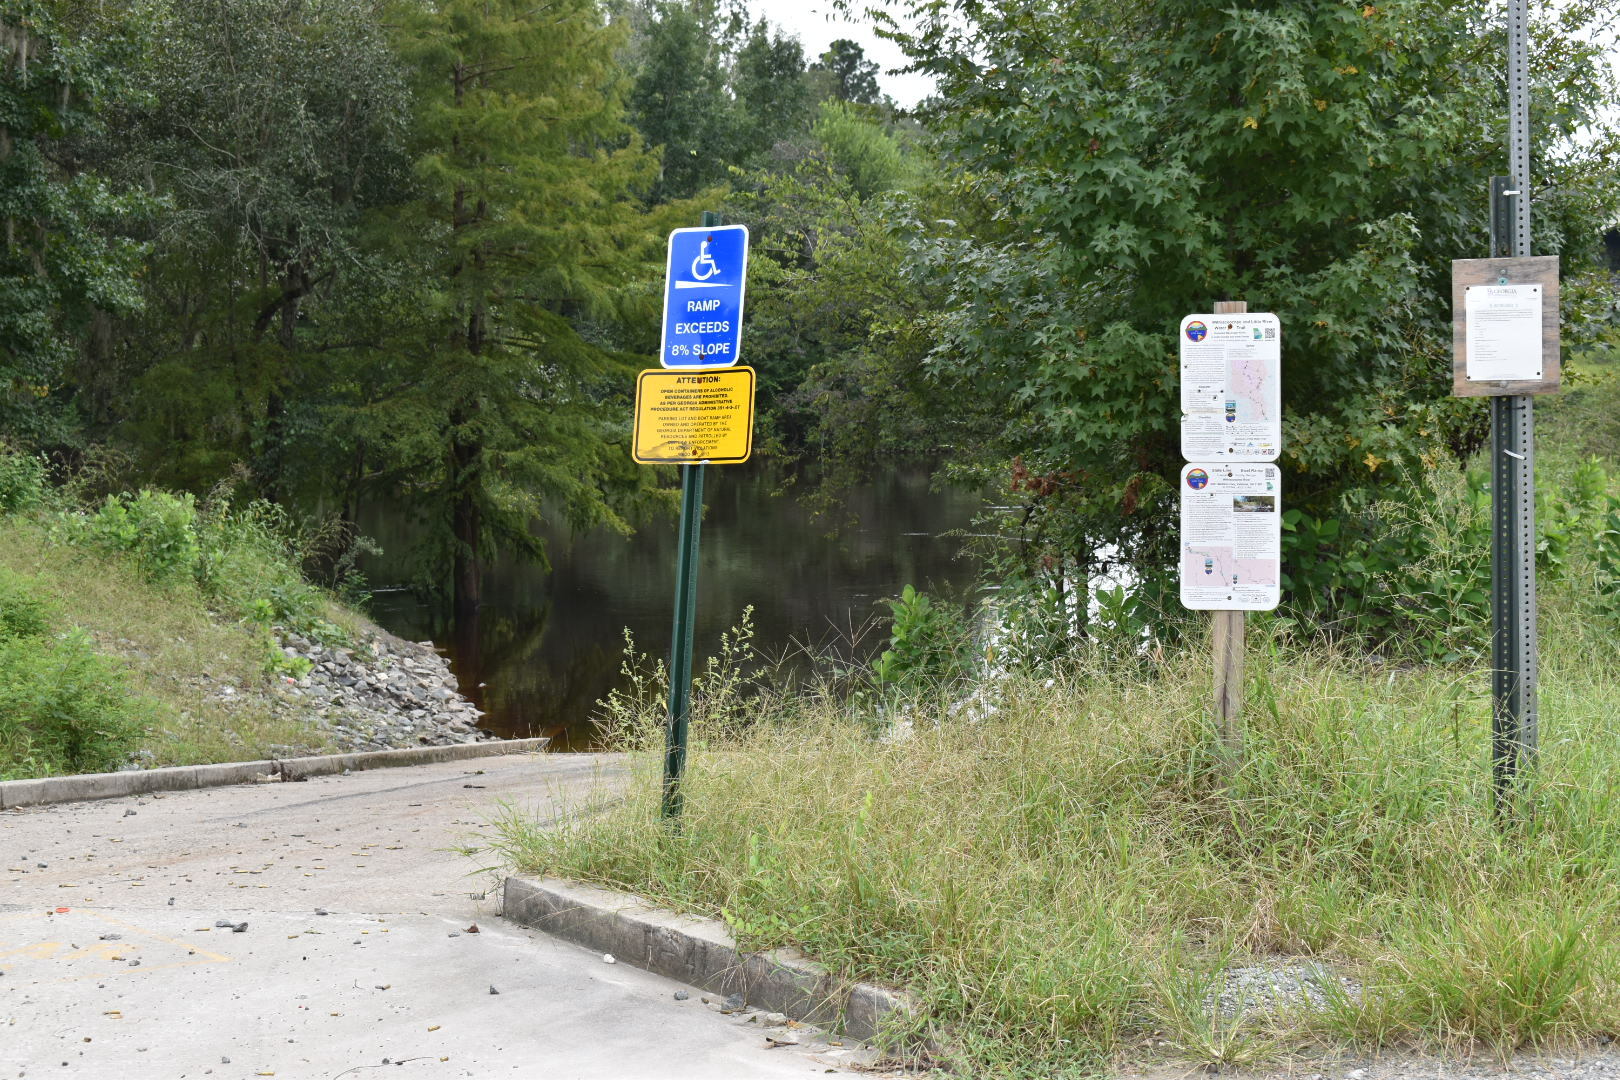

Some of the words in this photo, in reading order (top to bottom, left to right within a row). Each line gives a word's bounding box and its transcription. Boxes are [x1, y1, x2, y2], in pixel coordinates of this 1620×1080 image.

[687, 300, 720, 312] RAMP
[675, 321, 730, 334] EXCEEDS
[672, 345, 689, 356] 8%
[693, 343, 730, 355] SLOPE
